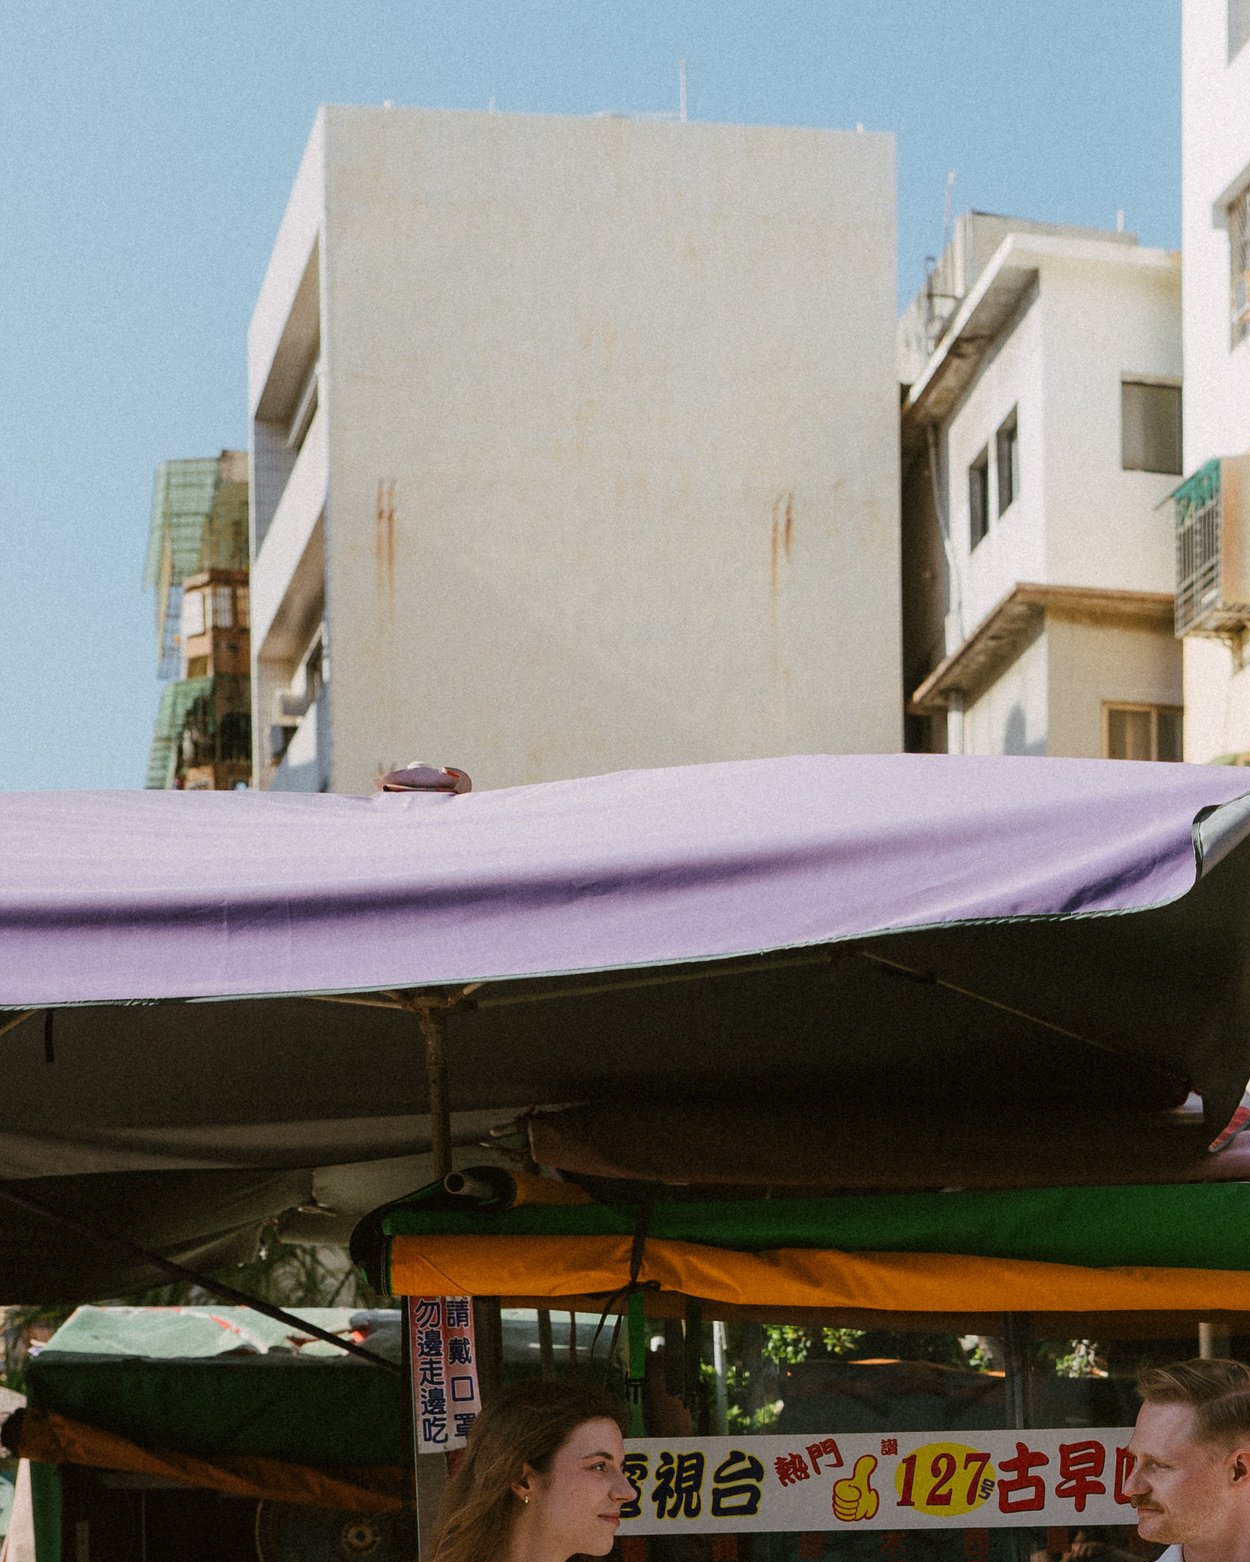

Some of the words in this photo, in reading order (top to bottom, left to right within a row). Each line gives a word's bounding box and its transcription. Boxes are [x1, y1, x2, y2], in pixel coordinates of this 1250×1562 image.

[415, 1300, 448, 1444] 勿邊走邊吃
[446, 1299, 476, 1438] 請戴口罩
[774, 1438, 844, 1487] 熱門
